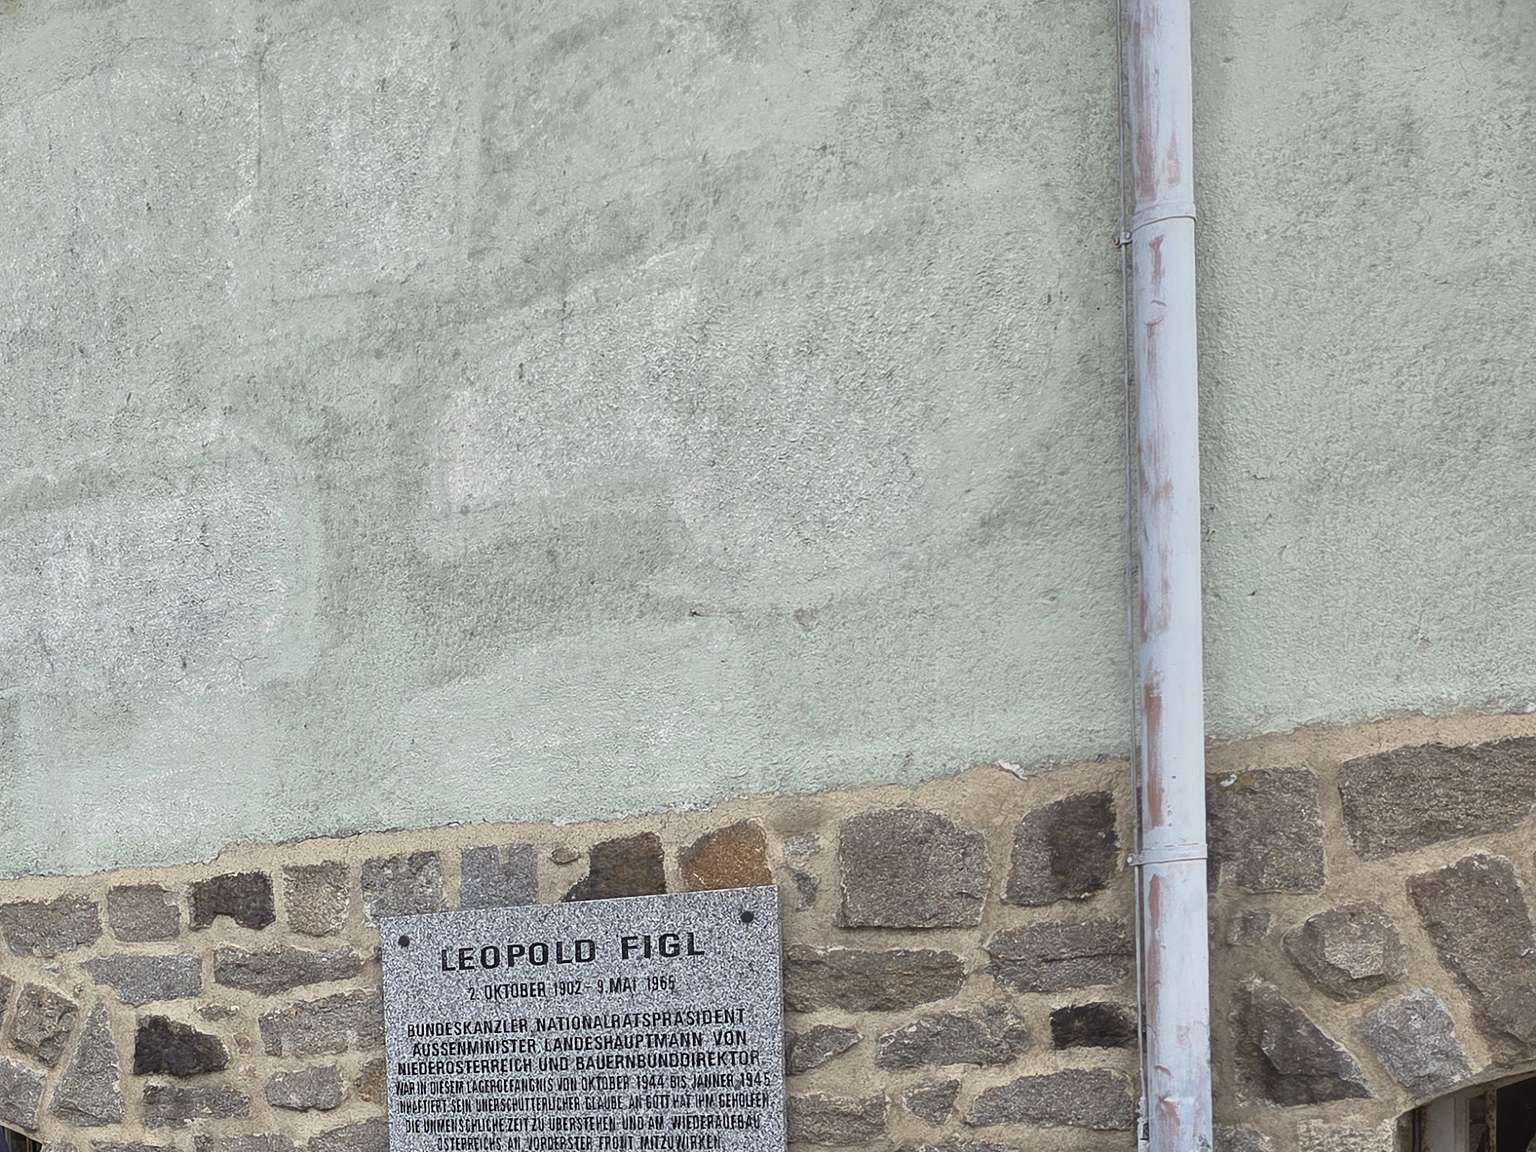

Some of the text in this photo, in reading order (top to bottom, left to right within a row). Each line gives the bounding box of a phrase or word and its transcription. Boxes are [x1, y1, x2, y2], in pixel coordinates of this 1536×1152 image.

[441, 932, 705, 971] LEOPOLD FIGL
[484, 982, 546, 1000] OKTOBER
[647, 975, 676, 992] 1965
[544, 1032, 704, 1051] LANDESHAUPTMANN
[714, 1030, 747, 1046] VON
[538, 1057, 568, 1072] UND
[417, 1081, 427, 1095] IN
[430, 1080, 464, 1095] DIESEM
[557, 1077, 577, 1092] VON
[581, 1075, 630, 1091] OKTOBER
[637, 1074, 665, 1090] 1944
[670, 1074, 687, 1089] BIS
[740, 1072, 771, 1087] 1945
[451, 1099, 472, 1113] SEIN
[585, 1095, 623, 1110] GLAUBE
[628, 1095, 642, 1109] AN
[646, 1094, 670, 1109] GOTT
[673, 1094, 692, 1108] HAT
[695, 1093, 714, 1108] IHM
[406, 1119, 421, 1133] DIE
[507, 1117, 529, 1132] ZEIT
[531, 1117, 545, 1132] ZU
[622, 1116, 644, 1131] UND
[648, 1115, 665, 1131] AM
[671, 1114, 761, 1130] WIEDERAUFBAU
[507, 1137, 521, 1151] AN
[528, 1136, 592, 1151] VORDERSTER
[598, 1135, 634, 1150] FRONT
